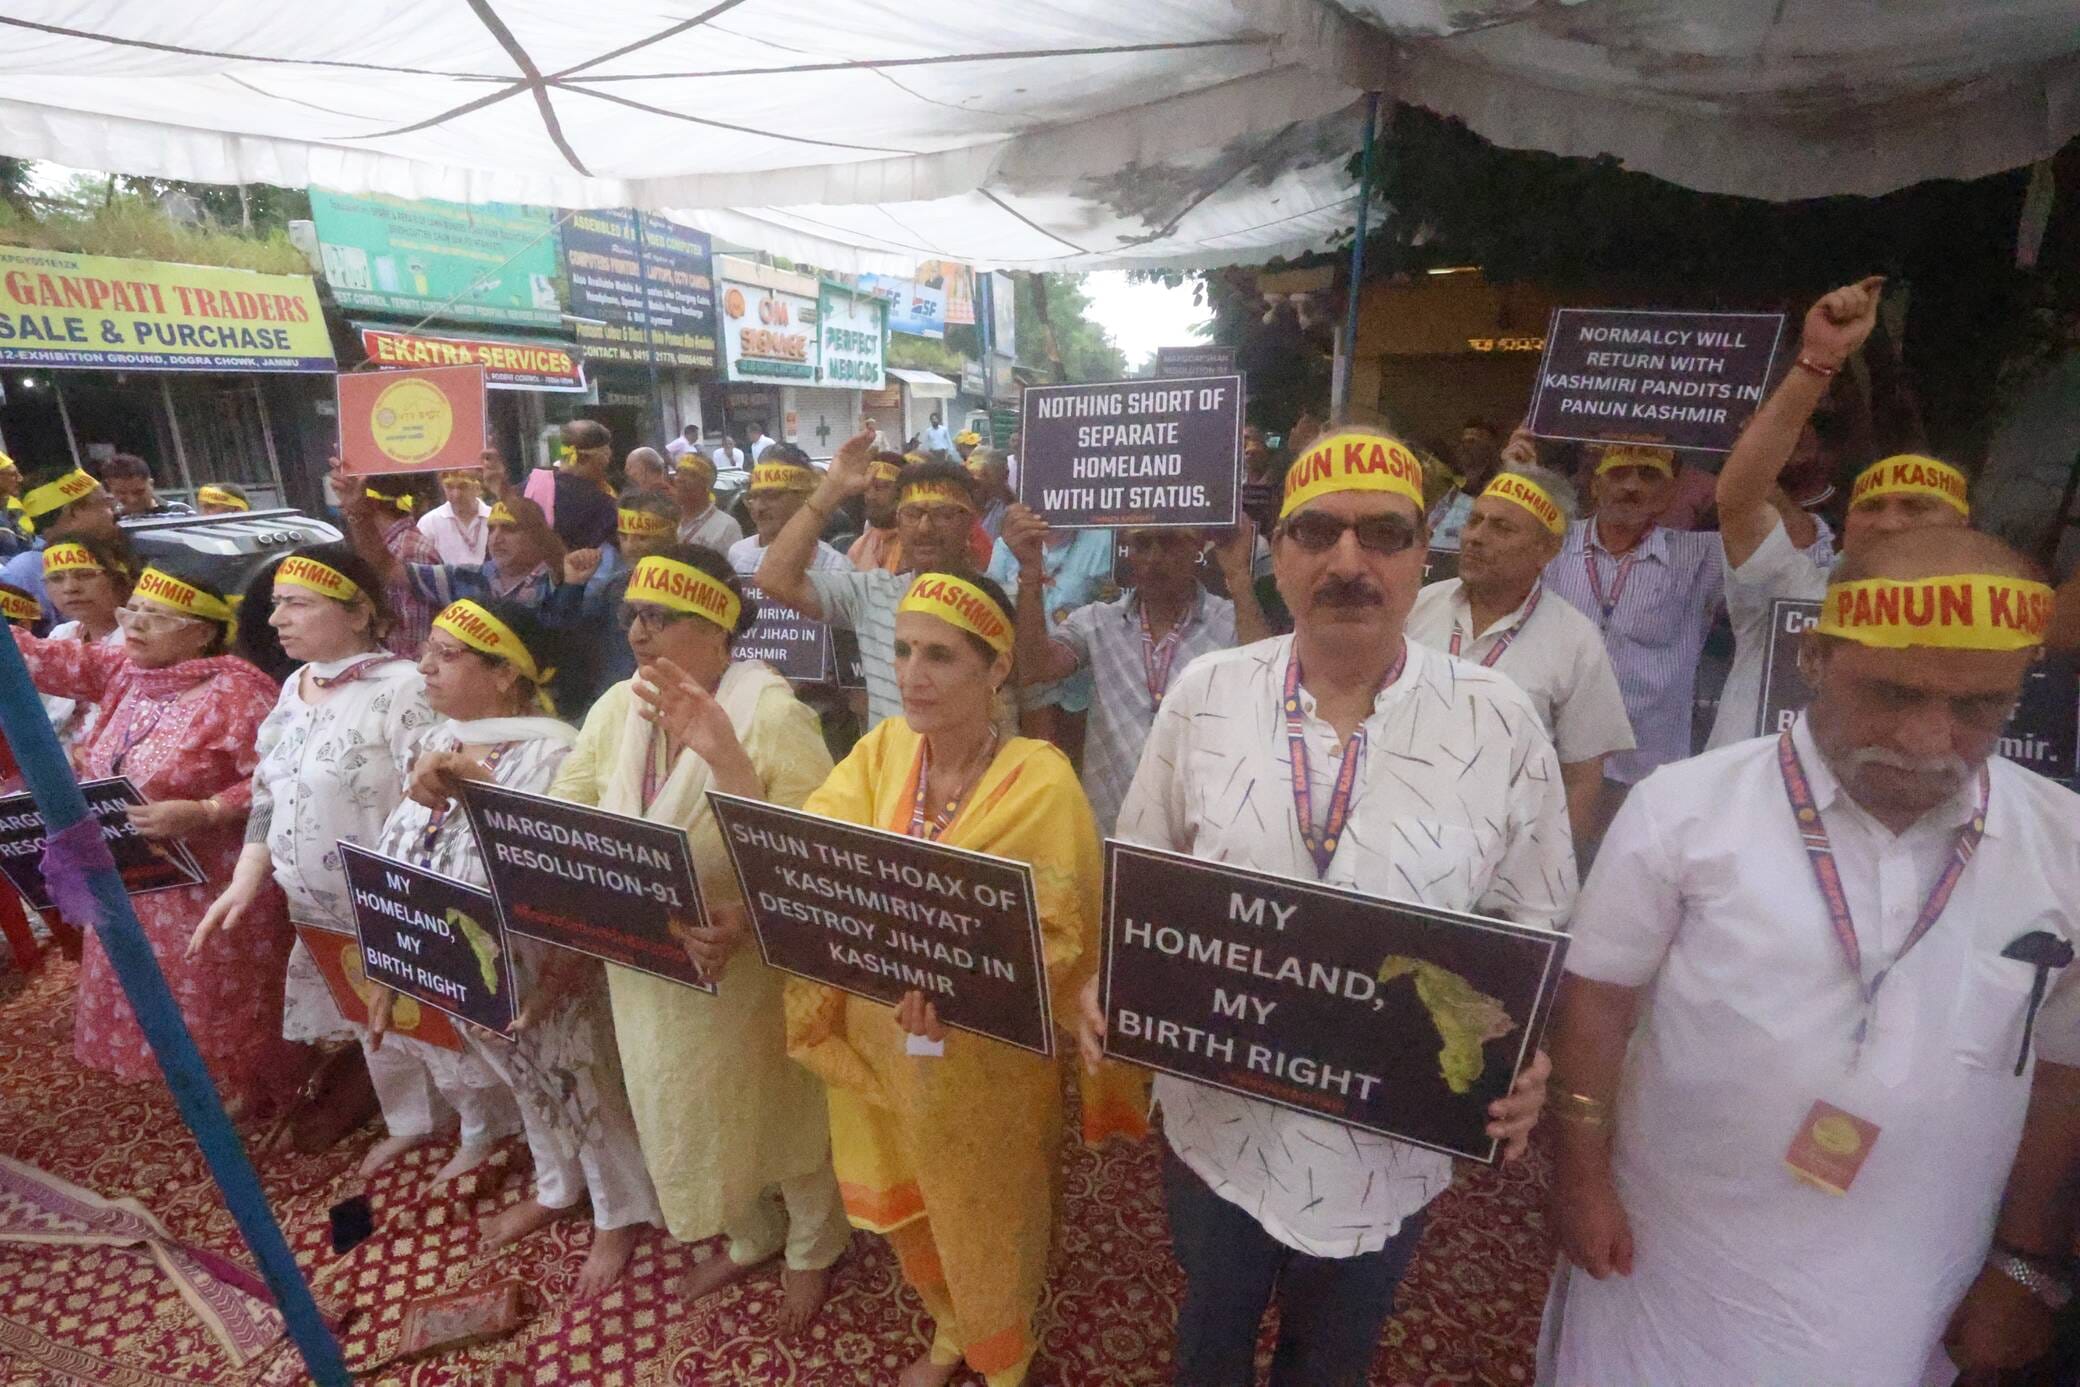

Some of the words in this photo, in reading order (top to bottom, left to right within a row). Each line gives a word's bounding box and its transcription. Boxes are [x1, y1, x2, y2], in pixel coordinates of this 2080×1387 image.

[5, 270, 167, 314] GANPATI
[172, 286, 309, 322] TRADERS
[0, 313, 88, 342] SALE
[101, 319, 125, 343] &
[133, 321, 291, 350] PURCHASE
[826, 326, 878, 355] PERFECT
[1580, 327, 1691, 346] NORMALCY
[1697, 331, 1747, 348] WILL
[170, 355, 210, 365] DOGRA
[214, 356, 259, 367] CHOWK,
[262, 358, 300, 367] JAMMU
[377, 337, 474, 363] EKATRA
[479, 348, 572, 373] SERVICES
[828, 358, 879, 383] MEDICOS
[1587, 352, 1664, 370] RETURN
[1670, 357, 1725, 373] WITH
[1038, 394, 1122, 418] NOTHING
[1128, 390, 1194, 414] SHORT
[1199, 388, 1225, 411] OF
[1545, 374, 1636, 393] KASHMIRI
[1641, 379, 1732, 399] PANDITS
[1737, 385, 1761, 400] IN
[1560, 399, 1627, 417] PANUN
[1631, 403, 1727, 424] KASHMIR
[1078, 423, 1179, 448] SEPARATE
[1073, 454, 1181, 478] HOMELAND
[1043, 488, 1094, 510] WITH
[1100, 487, 1125, 509] UT
[1129, 485, 1211, 508] STATUS.
[1490, 479, 1557, 526] KASHMIR
[140, 574, 197, 607] SHMIR
[643, 566, 729, 618] KASHMIR
[1838, 584, 1974, 627] PANUN
[443, 605, 501, 647] SHMIR
[912, 579, 1009, 641] KASHMIR
[732, 646, 788, 660] KASHMIR
[760, 629, 799, 640] JIHAD
[802, 629, 816, 641] IN
[483, 809, 673, 872] MARGDARSHAN
[386, 871, 411, 895] MY
[496, 842, 683, 908] RESOLUTION-91
[732, 823, 810, 860] SHUN
[813, 843, 872, 876] THE
[879, 859, 966, 900] HOAX
[974, 884, 1018, 912] OF
[355, 888, 456, 943] HOMELAND,
[1229, 892, 1298, 931] MY
[397, 931, 421, 955] MY
[759, 892, 876, 939] DESTROY
[885, 929, 974, 970] JIHAD
[984, 955, 1016, 983] IN
[367, 947, 413, 985] BIRTH
[418, 967, 467, 1003] RIGHT
[828, 942, 956, 997] KASHMIR
[1124, 918, 1384, 1011] HOMELAND,
[1213, 988, 1277, 1025] MY
[1118, 1008, 1234, 1063] BIRTH
[1247, 1044, 1382, 1101] RIGHT
